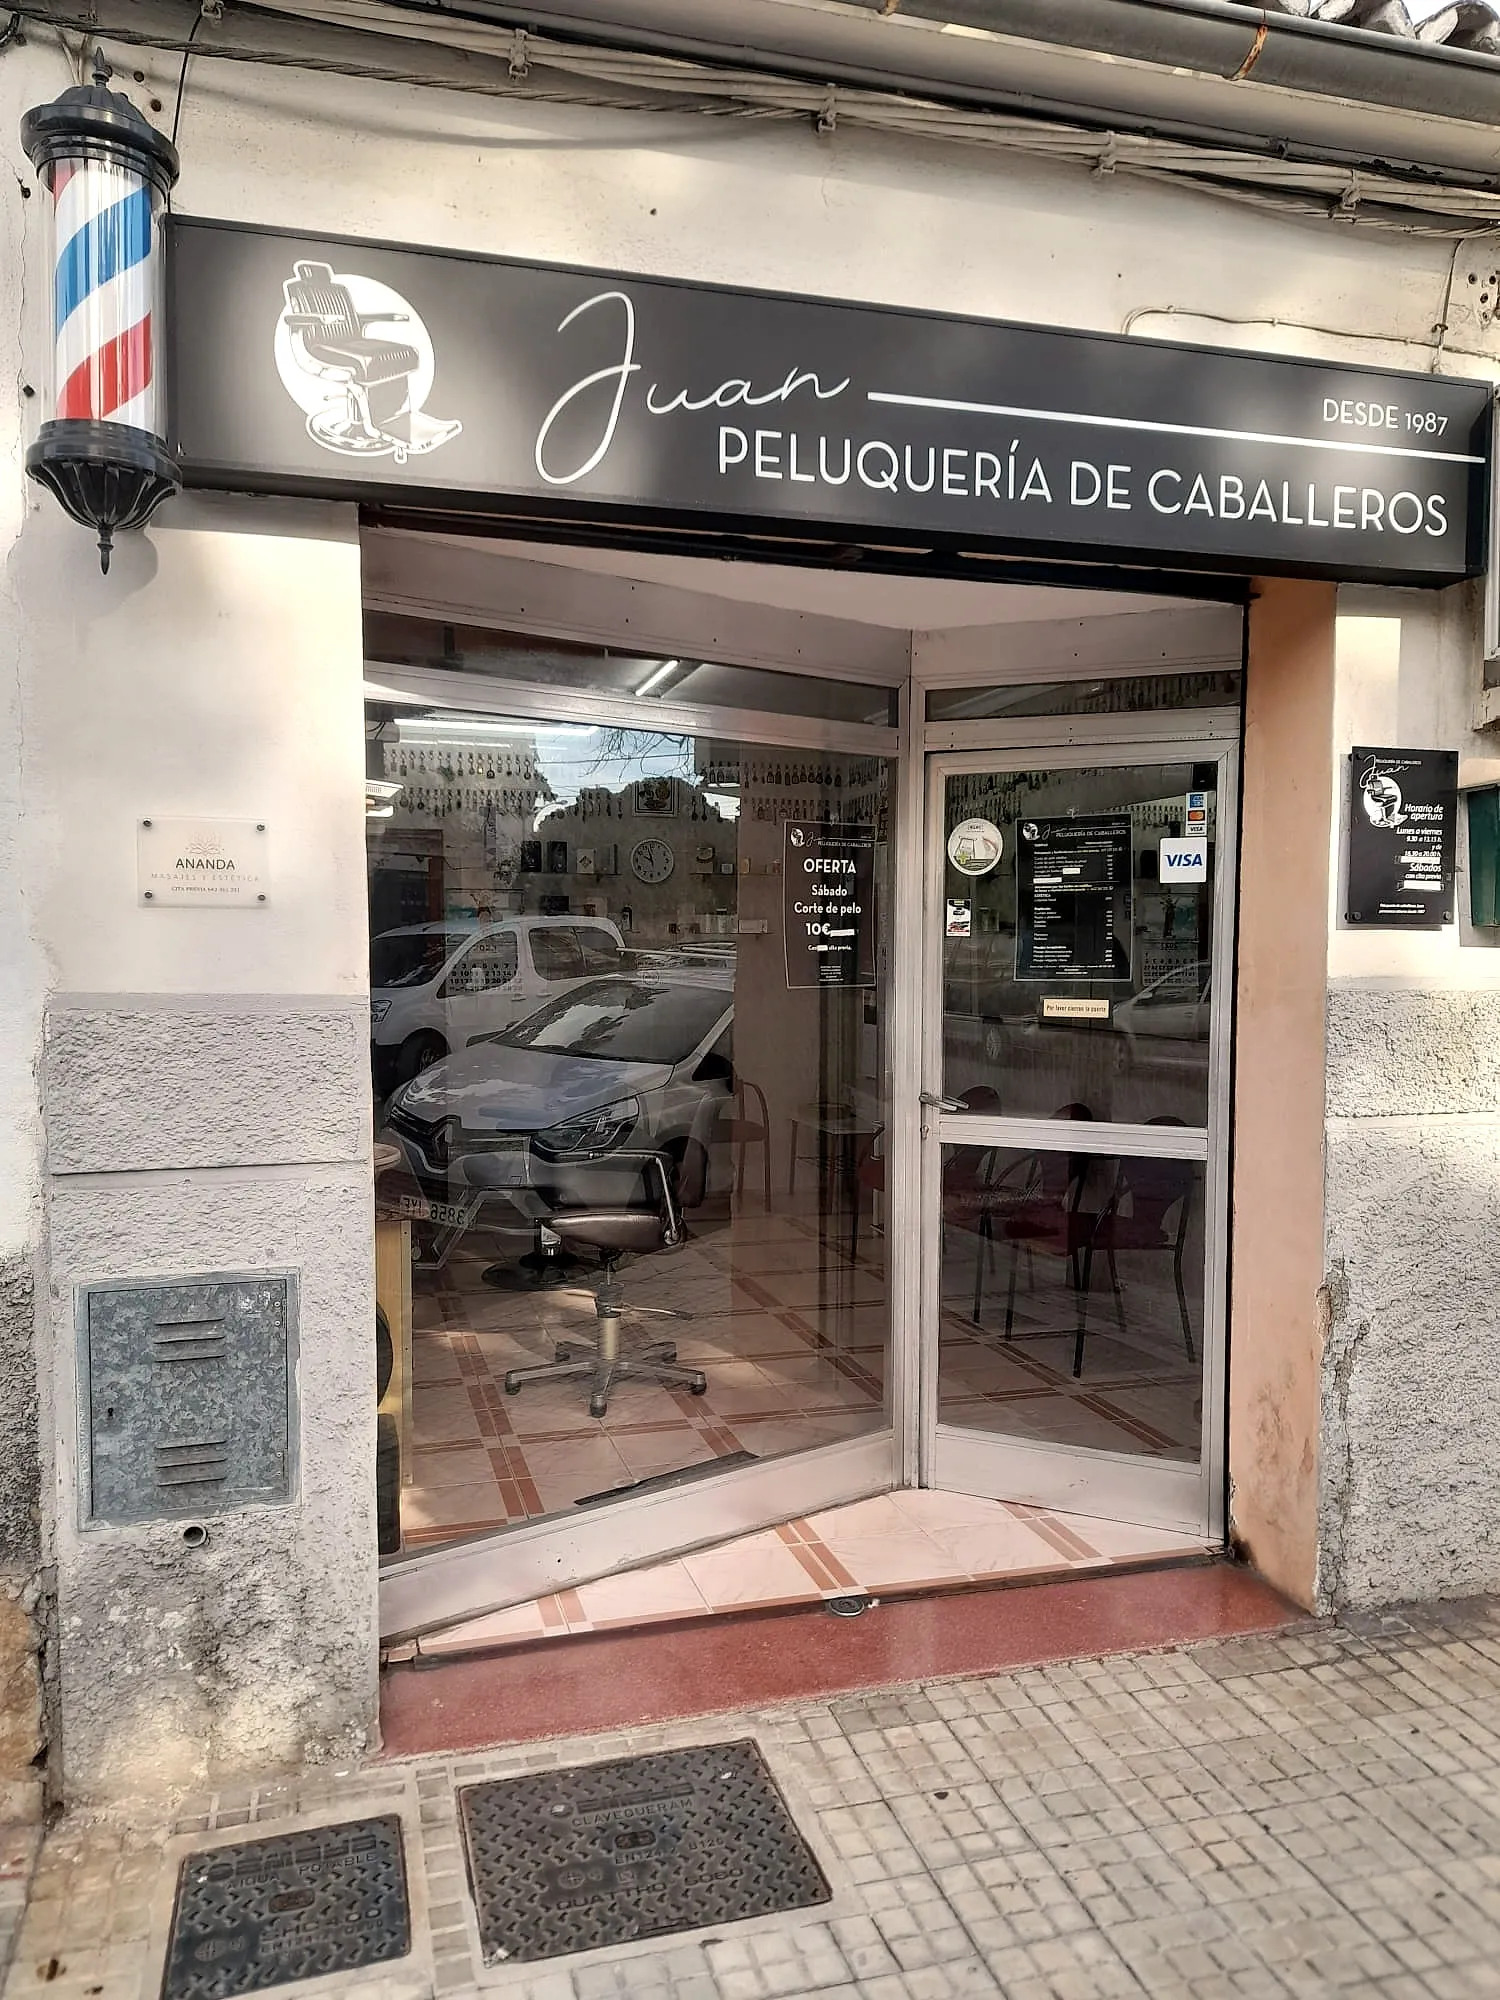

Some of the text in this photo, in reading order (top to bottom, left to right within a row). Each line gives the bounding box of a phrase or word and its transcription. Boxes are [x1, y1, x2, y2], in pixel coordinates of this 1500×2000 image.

[535, 291, 850, 485] Juan
[1322, 397, 1449, 438] DESDE 1987
[719, 425, 1449, 538] PELUQUERÍA DE CABALLEROS
[1359, 754, 1410, 788] Juan
[1404, 803, 1444, 813] Horario de
[1410, 813, 1443, 822] apertura
[1396, 826, 1415, 835] Lunes
[175, 858, 235, 870] ANANDA
[803, 858, 857, 874] OFERTA
[1163, 853, 1203, 868] VISA
[1409, 863, 1442, 872] Sábados
[811, 884, 848, 897] Sábado
[794, 901, 862, 917] Corte de pelo
[805, 922, 831, 936] 10€
[297, 1851, 379, 1876] POTABLE
